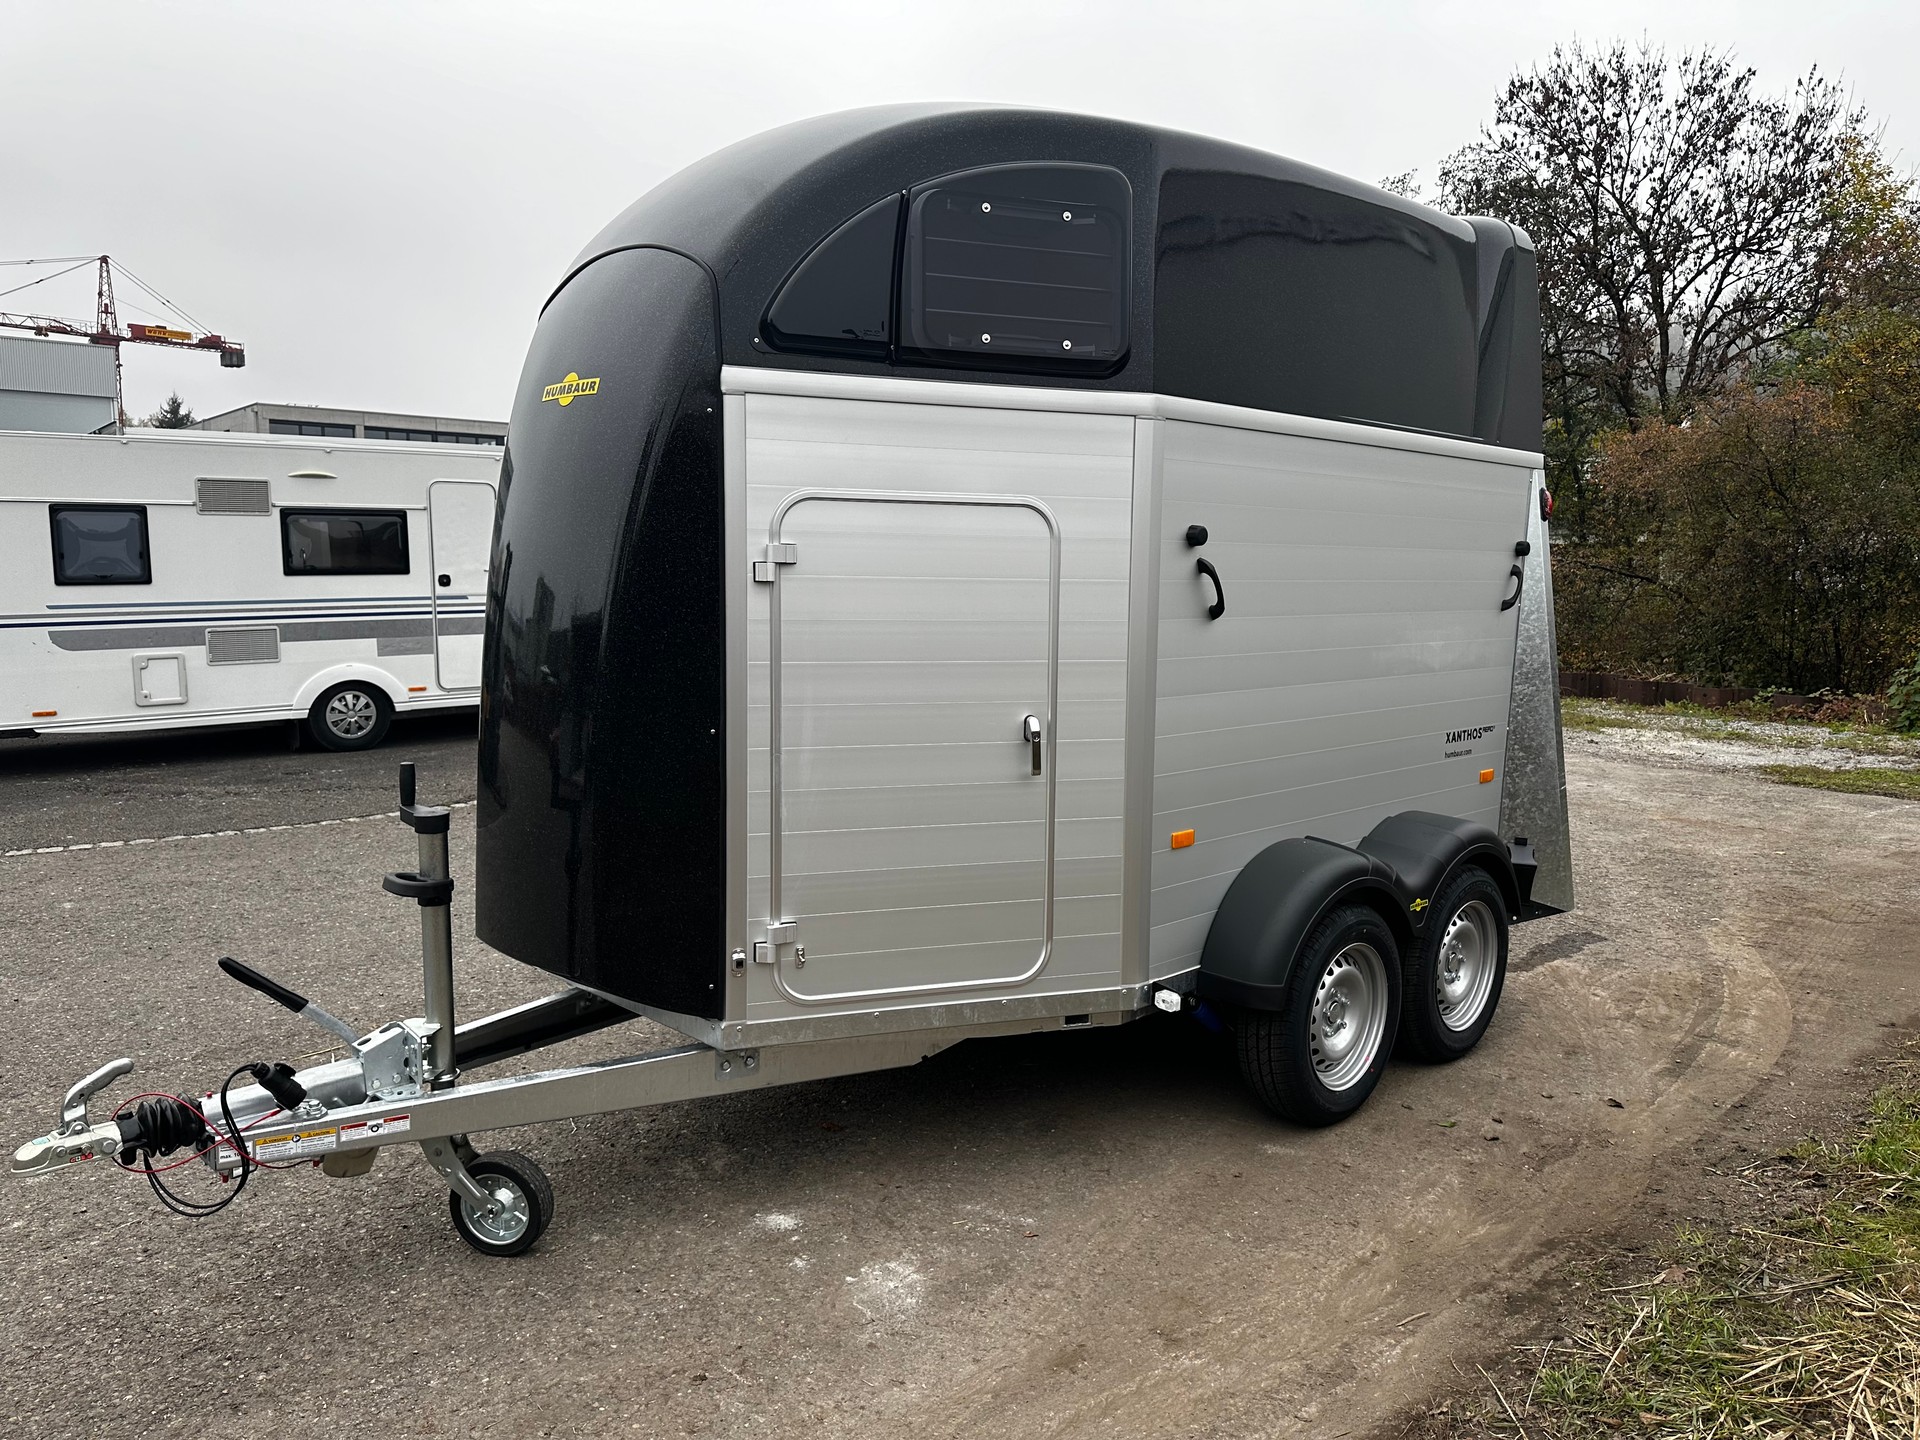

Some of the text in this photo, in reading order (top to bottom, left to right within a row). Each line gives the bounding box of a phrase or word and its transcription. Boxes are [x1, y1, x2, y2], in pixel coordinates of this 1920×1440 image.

[544, 380, 597, 399] HUMBAUR
[1445, 728, 1483, 744] XANTHOS
[1445, 749, 1472, 758] humbaur.com
